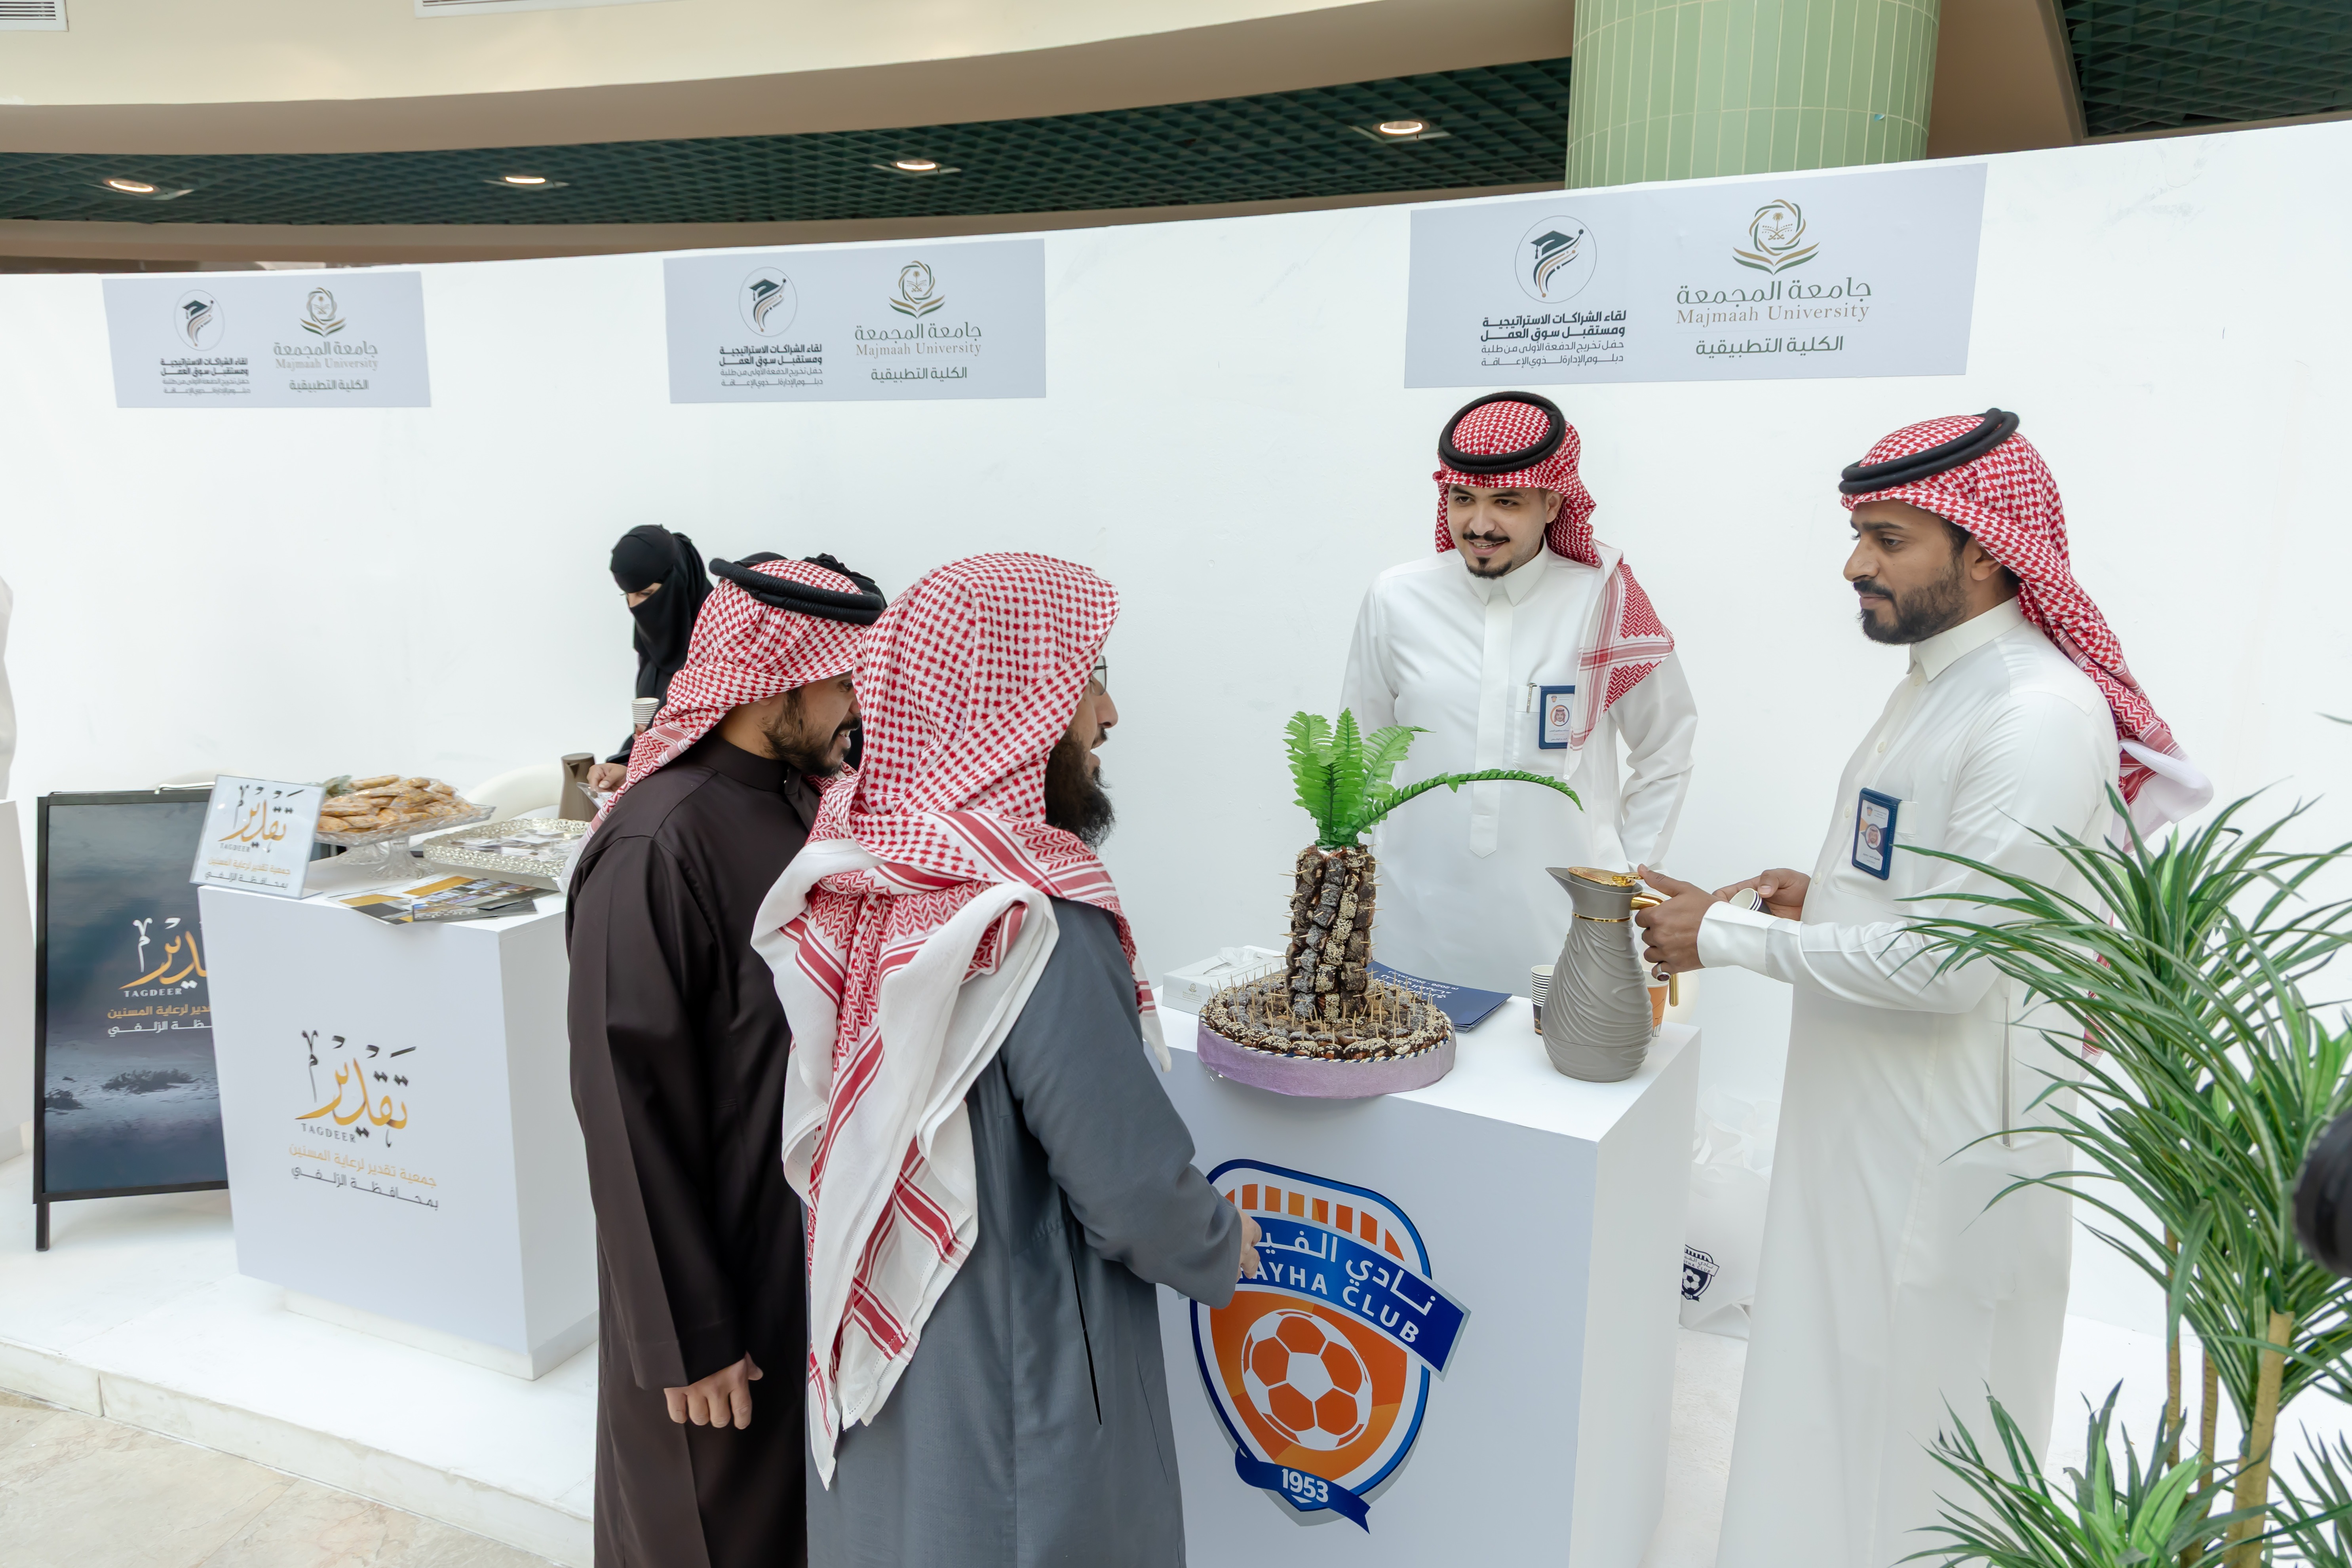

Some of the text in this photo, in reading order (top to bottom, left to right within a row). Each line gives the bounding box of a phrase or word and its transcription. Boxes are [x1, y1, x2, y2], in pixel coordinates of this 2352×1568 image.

[1677, 277, 1871, 308] جامعة المجمعة
[1483, 310, 1627, 329] لقاء الشراكات الاستراتيجية
[1676, 302, 1870, 328] Majmaah University
[854, 321, 982, 344] جامعة المجمعة
[1481, 325, 1626, 342] ومستقبل سوق العمل
[273, 340, 378, 359] جامعة المجمعة
[770, 343, 805, 355] الشراكات
[806, 344, 822, 353] لقاء
[856, 341, 981, 359] Majmaah University
[1481, 344, 1503, 355] طلبة
[1504, 345, 1517, 354] من
[1545, 342, 1576, 351] الدفعة
[1576, 340, 1601, 353] تخريج
[1602, 340, 1624, 350] حفل
[1696, 335, 1844, 358] الكلية التطبيقية
[275, 357, 378, 371] Majmaah University
[719, 355, 822, 367] ومستقبل سوق العمل
[1585, 354, 1624, 366] دبلوم
[871, 367, 967, 383] الكلية التطبيقية
[289, 379, 369, 393] الكلية التطبيقية
[124, 988, 183, 998] TAGDEER
[107, 1006, 153, 1019] المسنين
[156, 1004, 188, 1017] لرعاية
[301, 1123, 356, 1143] TAGDEER
[289, 1144, 437, 1189] جمعية تقدير لرعاية المسنين
[291, 1167, 439, 1211] بمحافظة الزلفي
[1254, 1230, 1436, 1316] نادي الفي
[1240, 1260, 1419, 1343] AYHA CLUB
[1282, 1468, 1329, 1503] 1953
